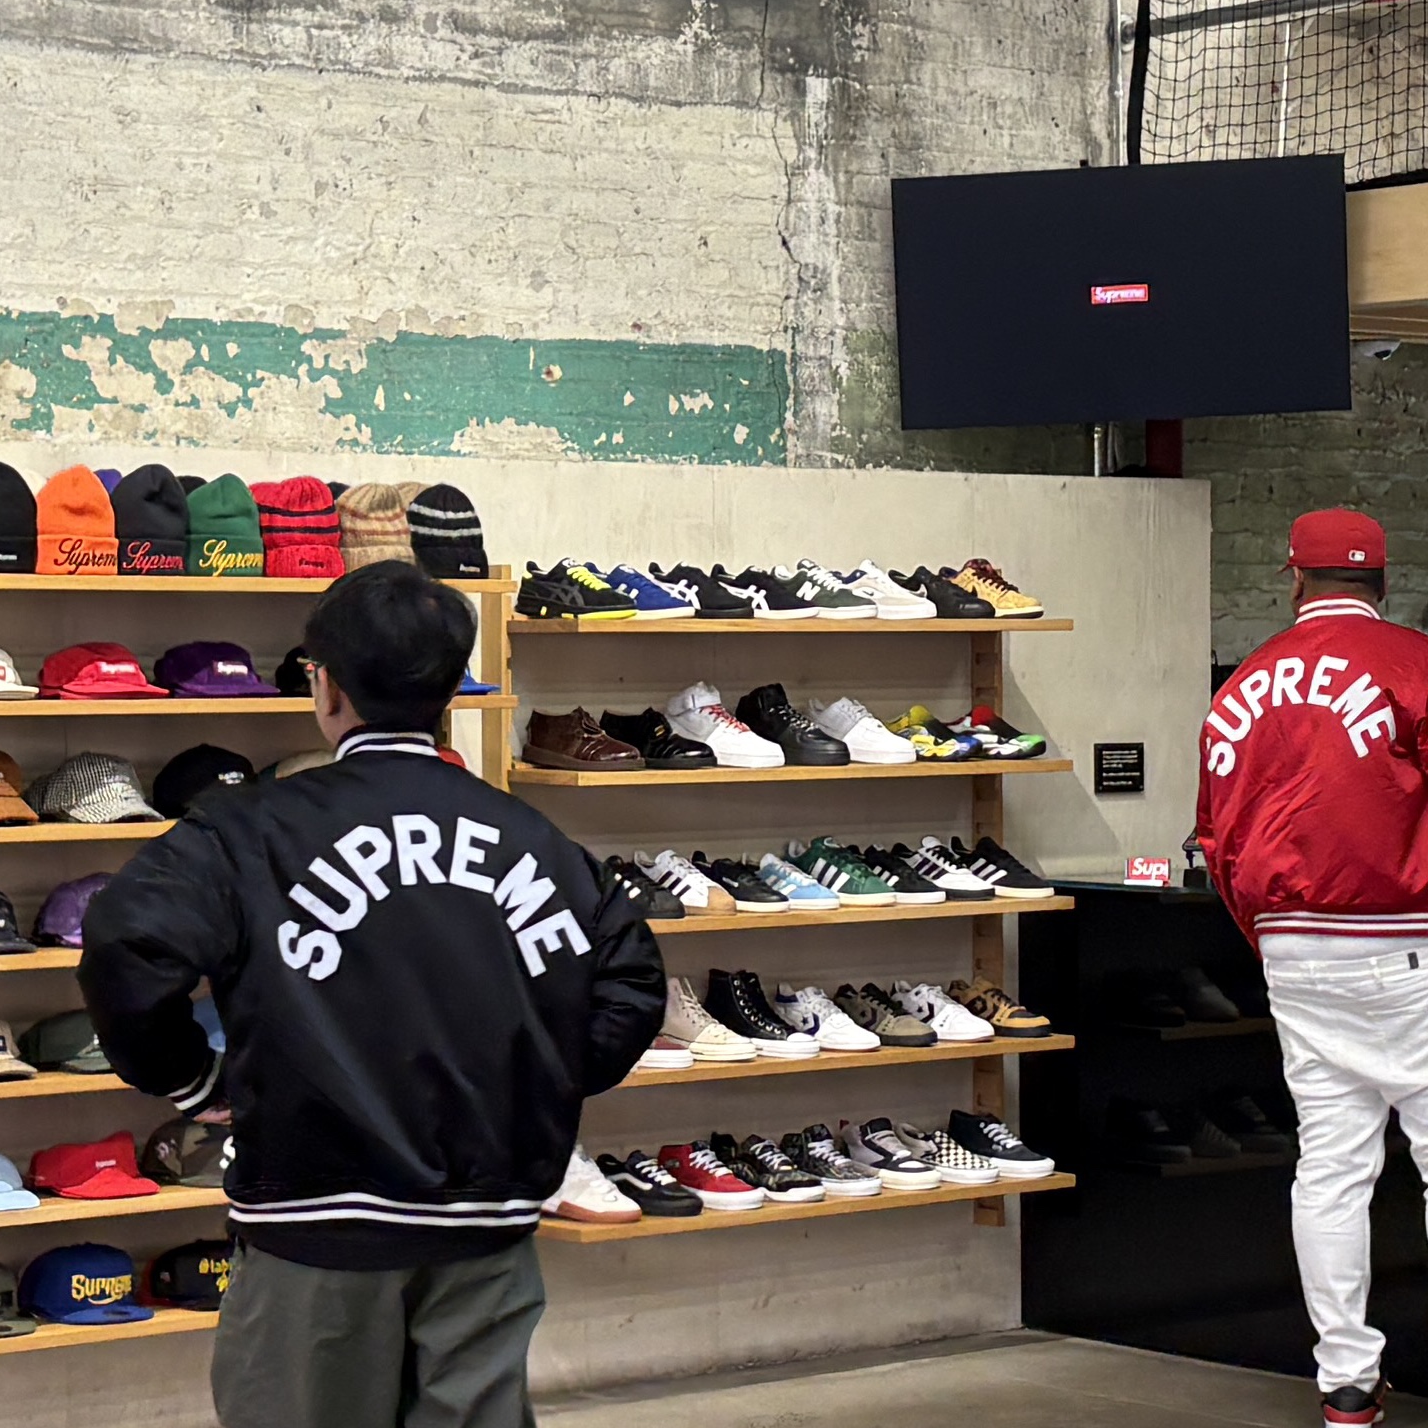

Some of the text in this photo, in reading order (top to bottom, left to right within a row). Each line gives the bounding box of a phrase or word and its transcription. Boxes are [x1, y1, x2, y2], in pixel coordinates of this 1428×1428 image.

[54, 537, 117, 575] Suprem
[123, 539, 184, 574] Suprem
[199, 538, 264, 577] Suprem
[1206, 655, 1397, 777] SUPREME
[278, 814, 592, 982] SUPREME
